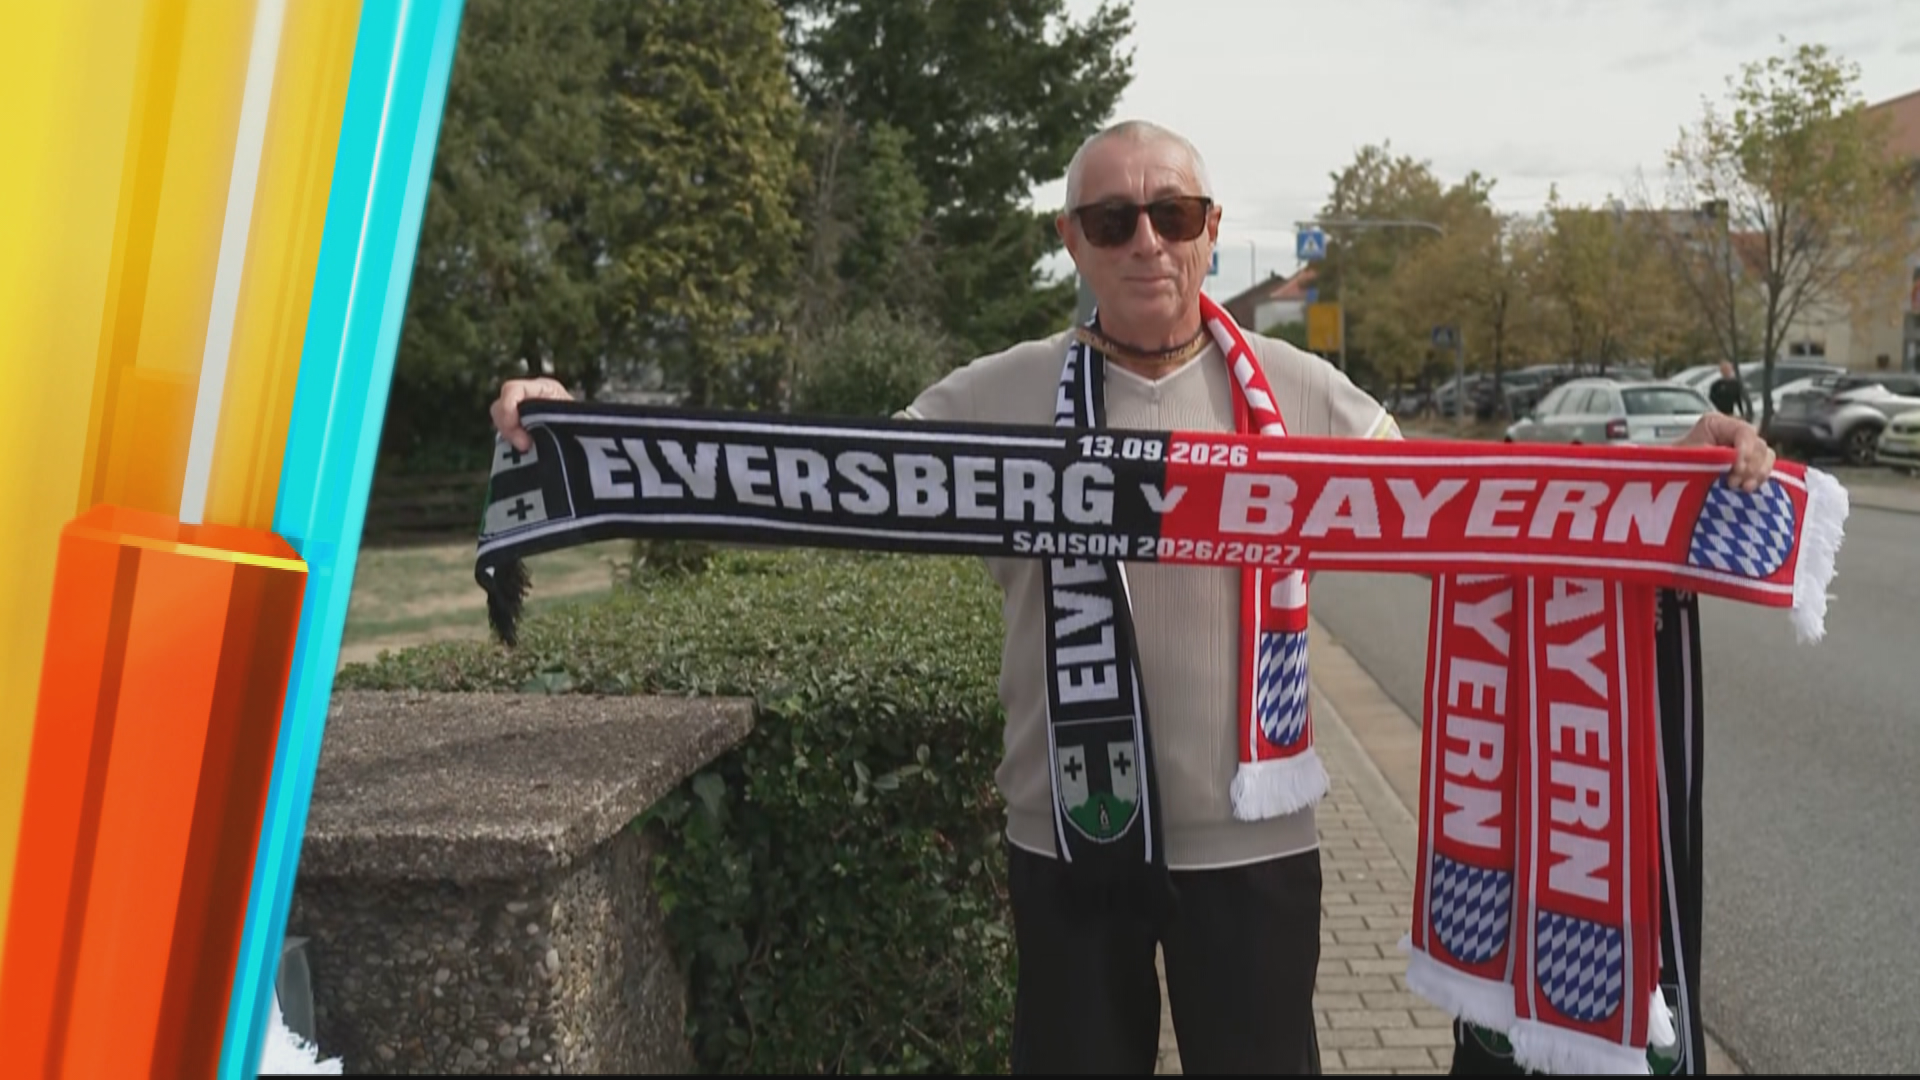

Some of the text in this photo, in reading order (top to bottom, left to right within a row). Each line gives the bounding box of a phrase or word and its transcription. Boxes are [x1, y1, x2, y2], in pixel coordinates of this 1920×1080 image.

[574, 434, 1115, 526] ELVERSBERG
[1218, 471, 1690, 548] BAYERN
[1077, 434, 1250, 467] 13.09.2026
[1012, 530, 1302, 566] SAISON 2026/2027
[1442, 573, 1513, 850] YERN
[1544, 576, 1611, 904] AYERN
